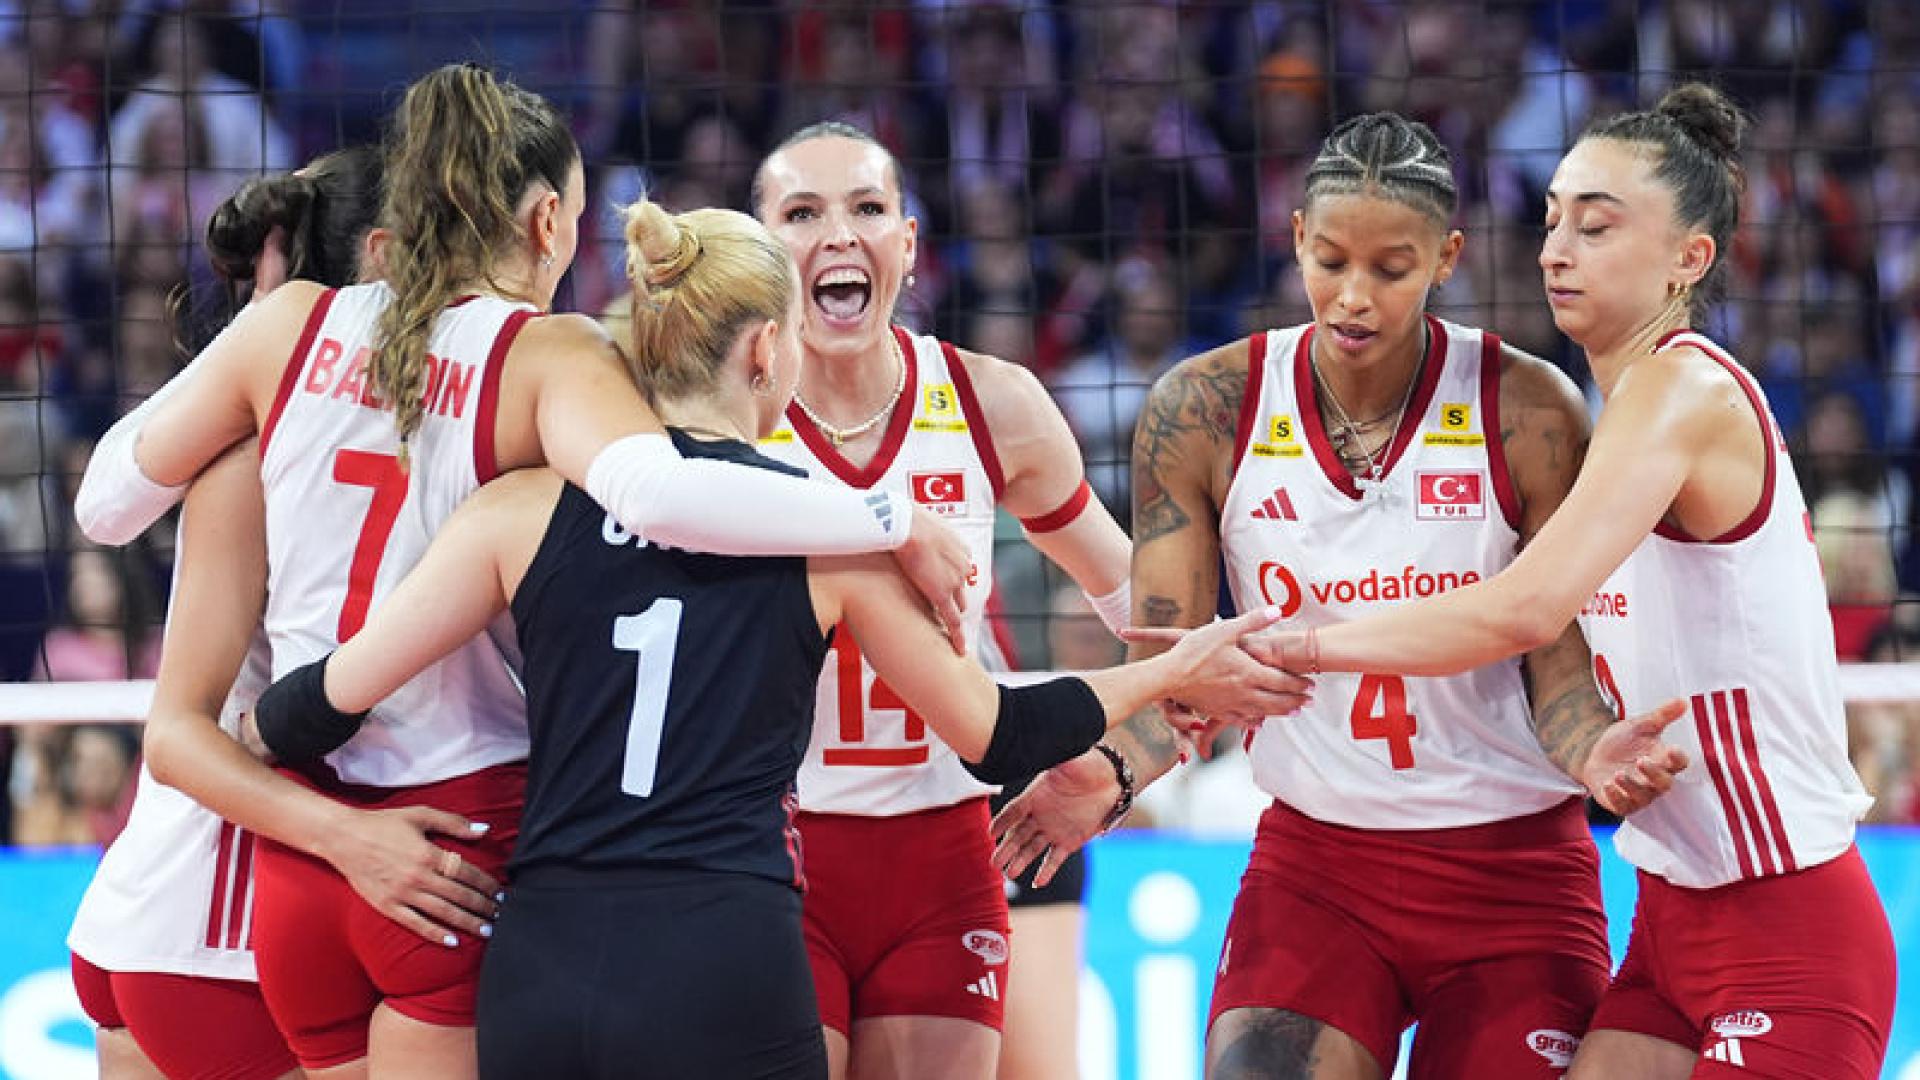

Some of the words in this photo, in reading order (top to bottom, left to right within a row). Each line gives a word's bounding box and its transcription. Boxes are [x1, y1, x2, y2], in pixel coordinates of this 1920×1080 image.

[1277, 421, 1290, 438] S
[1447, 408, 1464, 425] S
[1432, 505, 1467, 515] TUR
[333, 448, 410, 644] 7
[1310, 566, 1481, 605] vodafone
[612, 597, 683, 798] 1
[1350, 673, 1417, 769] 4
